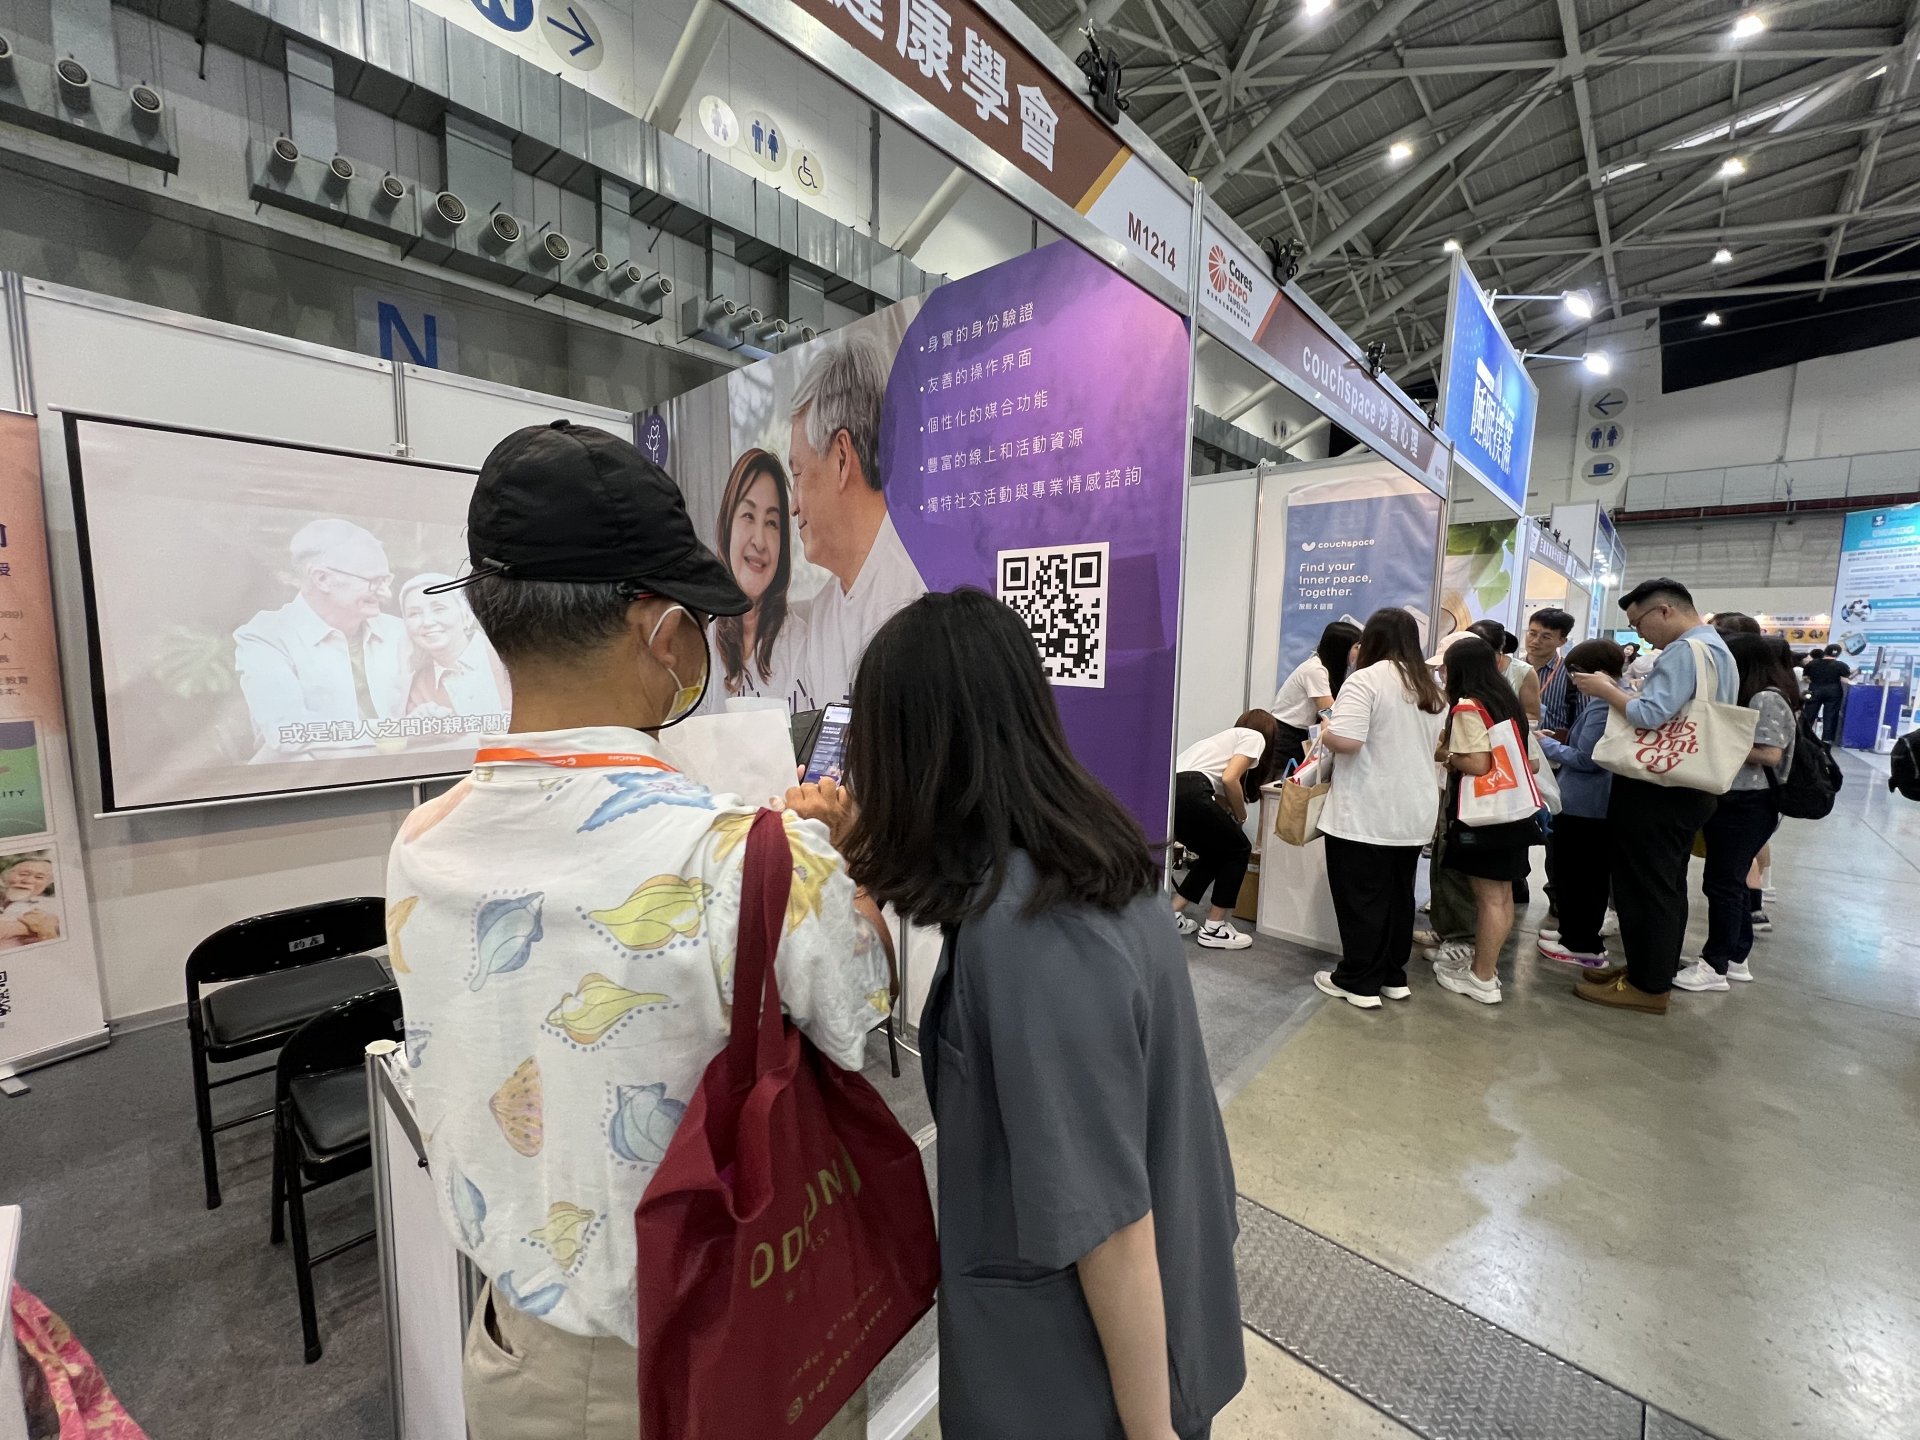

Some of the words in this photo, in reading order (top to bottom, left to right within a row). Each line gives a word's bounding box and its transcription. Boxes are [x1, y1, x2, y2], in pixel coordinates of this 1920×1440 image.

[1128, 211, 1176, 272] M1214
[1228, 281, 1248, 304] EXPO
[1229, 259, 1253, 293] Cares
[378, 301, 438, 369] N
[927, 348, 1032, 394] 友善的操作界面
[1303, 346, 1376, 423] couchspace
[927, 389, 1048, 434] 個性化的媒合功能
[927, 427, 1084, 474] 豐富的線上和活動資源
[927, 465, 1142, 513] 獨特社交活動與專業情感諮詢
[1318, 539, 1375, 549] couchspace
[1299, 575, 1330, 585] Inner
[1333, 574, 1372, 585] peace,
[1300, 562, 1325, 572] Find
[1328, 562, 1356, 573] your
[1299, 587, 1353, 599] Together.
[1633, 727, 1699, 754] Don't
[1636, 747, 1684, 775] Cry
